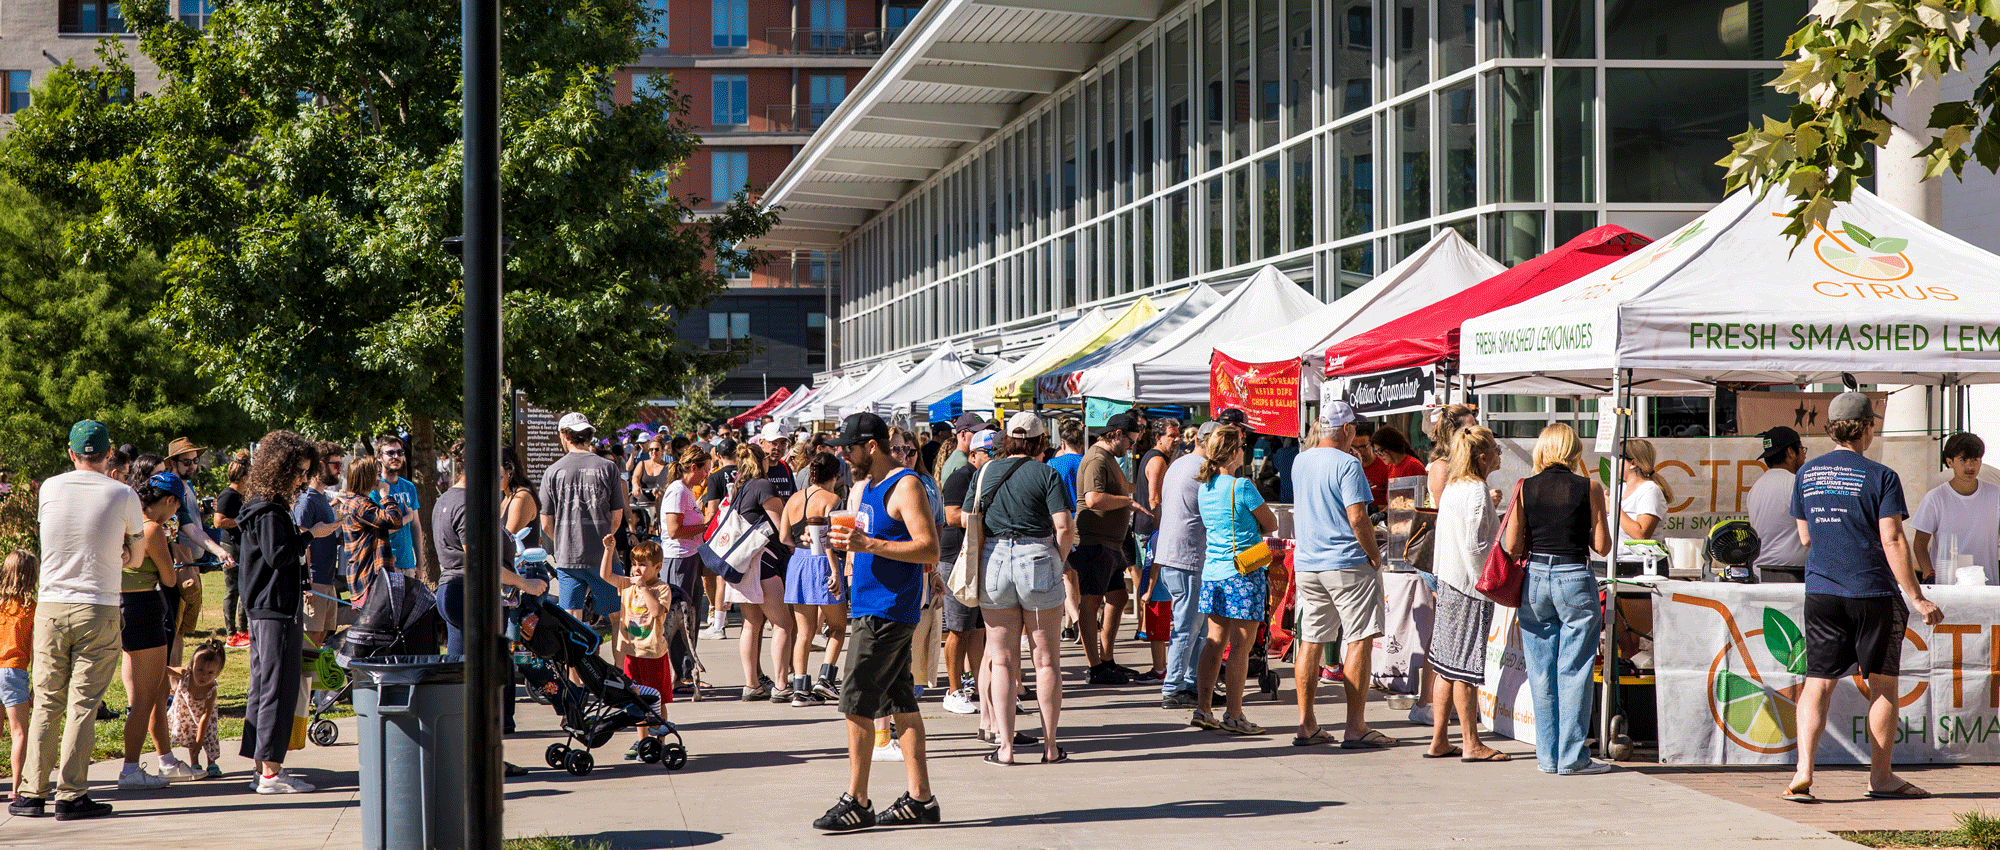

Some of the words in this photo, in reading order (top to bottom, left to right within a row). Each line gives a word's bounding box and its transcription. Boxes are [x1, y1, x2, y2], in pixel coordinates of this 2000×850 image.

[1812, 281, 1959, 301] CTRUS
[1475, 331, 1497, 356] FRESH
[1498, 327, 1535, 354] SMASHED
[1536, 322, 1593, 351] LEMONADES
[1690, 322, 1776, 350] FRESH
[1788, 323, 1930, 351] SMASHED
[1943, 324, 2000, 352] LEM
[1269, 377, 1299, 386] SPREADS
[1255, 388, 1275, 396] KEFIR
[1276, 388, 1293, 396] DIPS
[1803, 470, 1838, 480] Trustworthy
